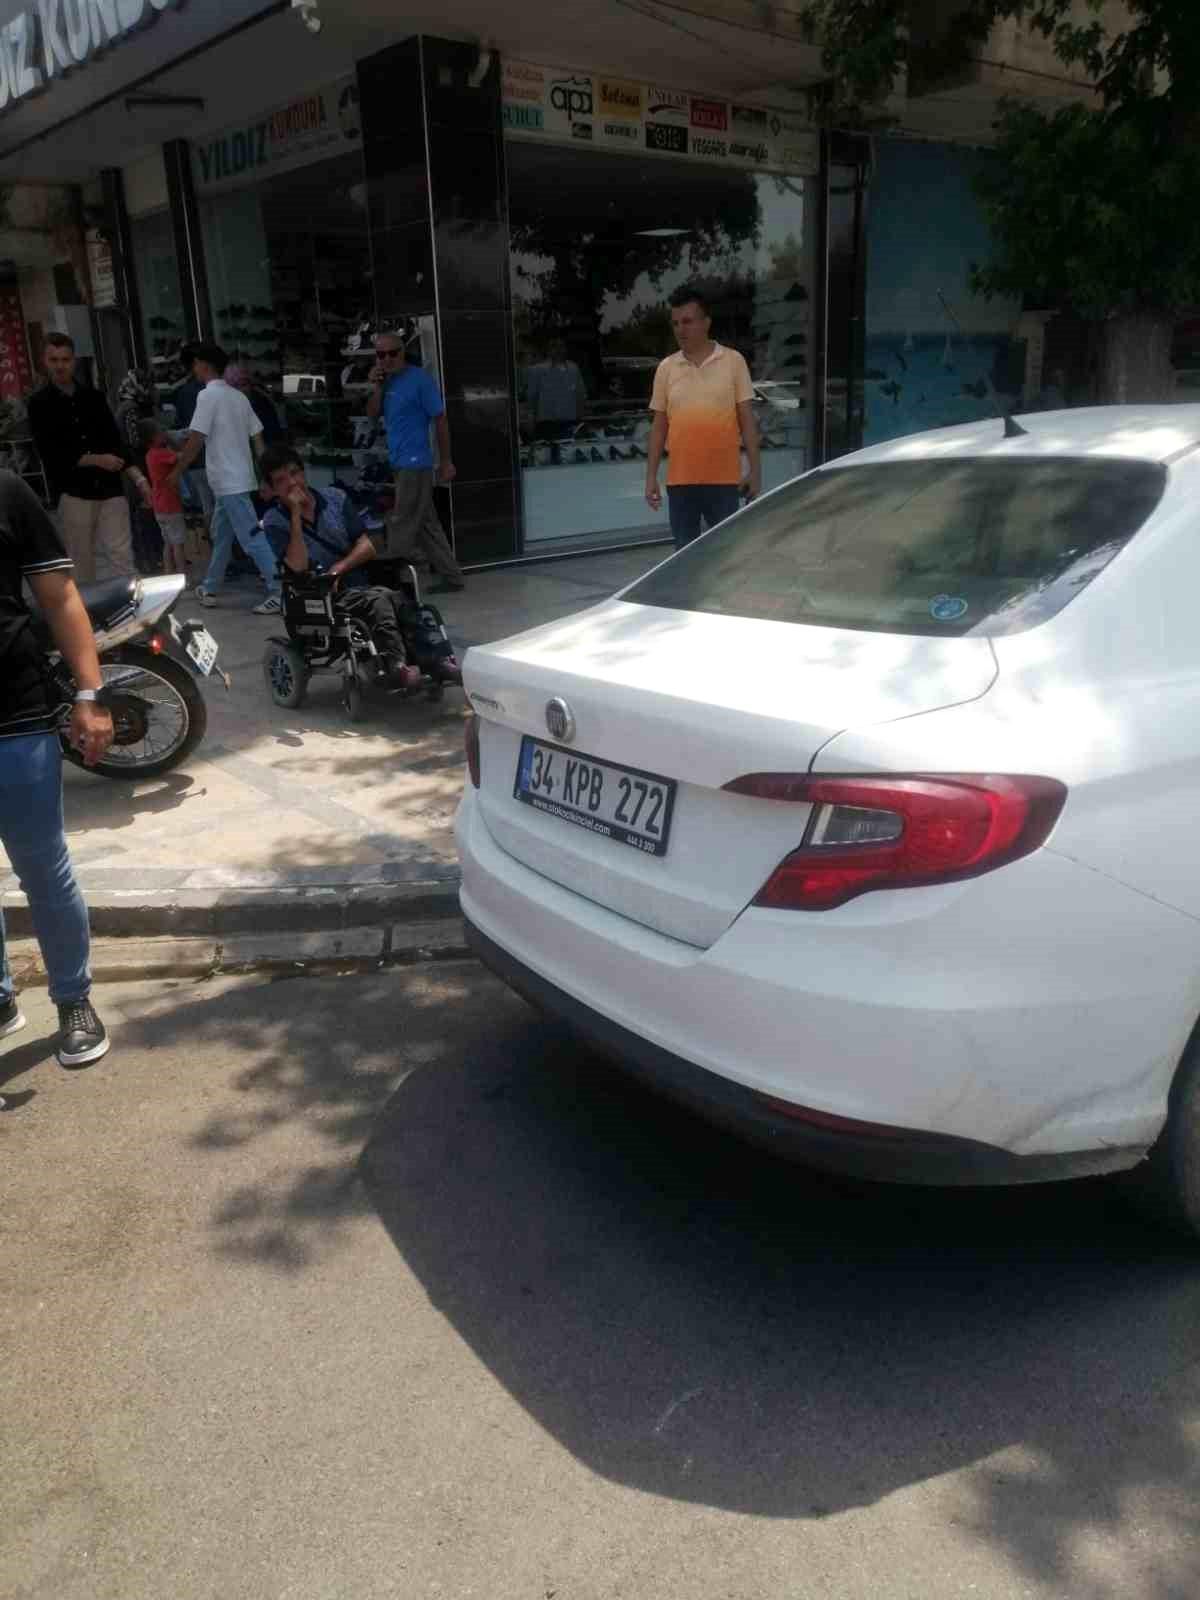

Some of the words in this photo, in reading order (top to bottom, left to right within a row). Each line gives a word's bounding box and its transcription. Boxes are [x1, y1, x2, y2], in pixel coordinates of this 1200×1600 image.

[193, 121, 268, 183] YILDIZ
[532, 749, 553, 795] 34
[563, 759, 603, 812] KPB
[615, 776, 663, 836] 272
